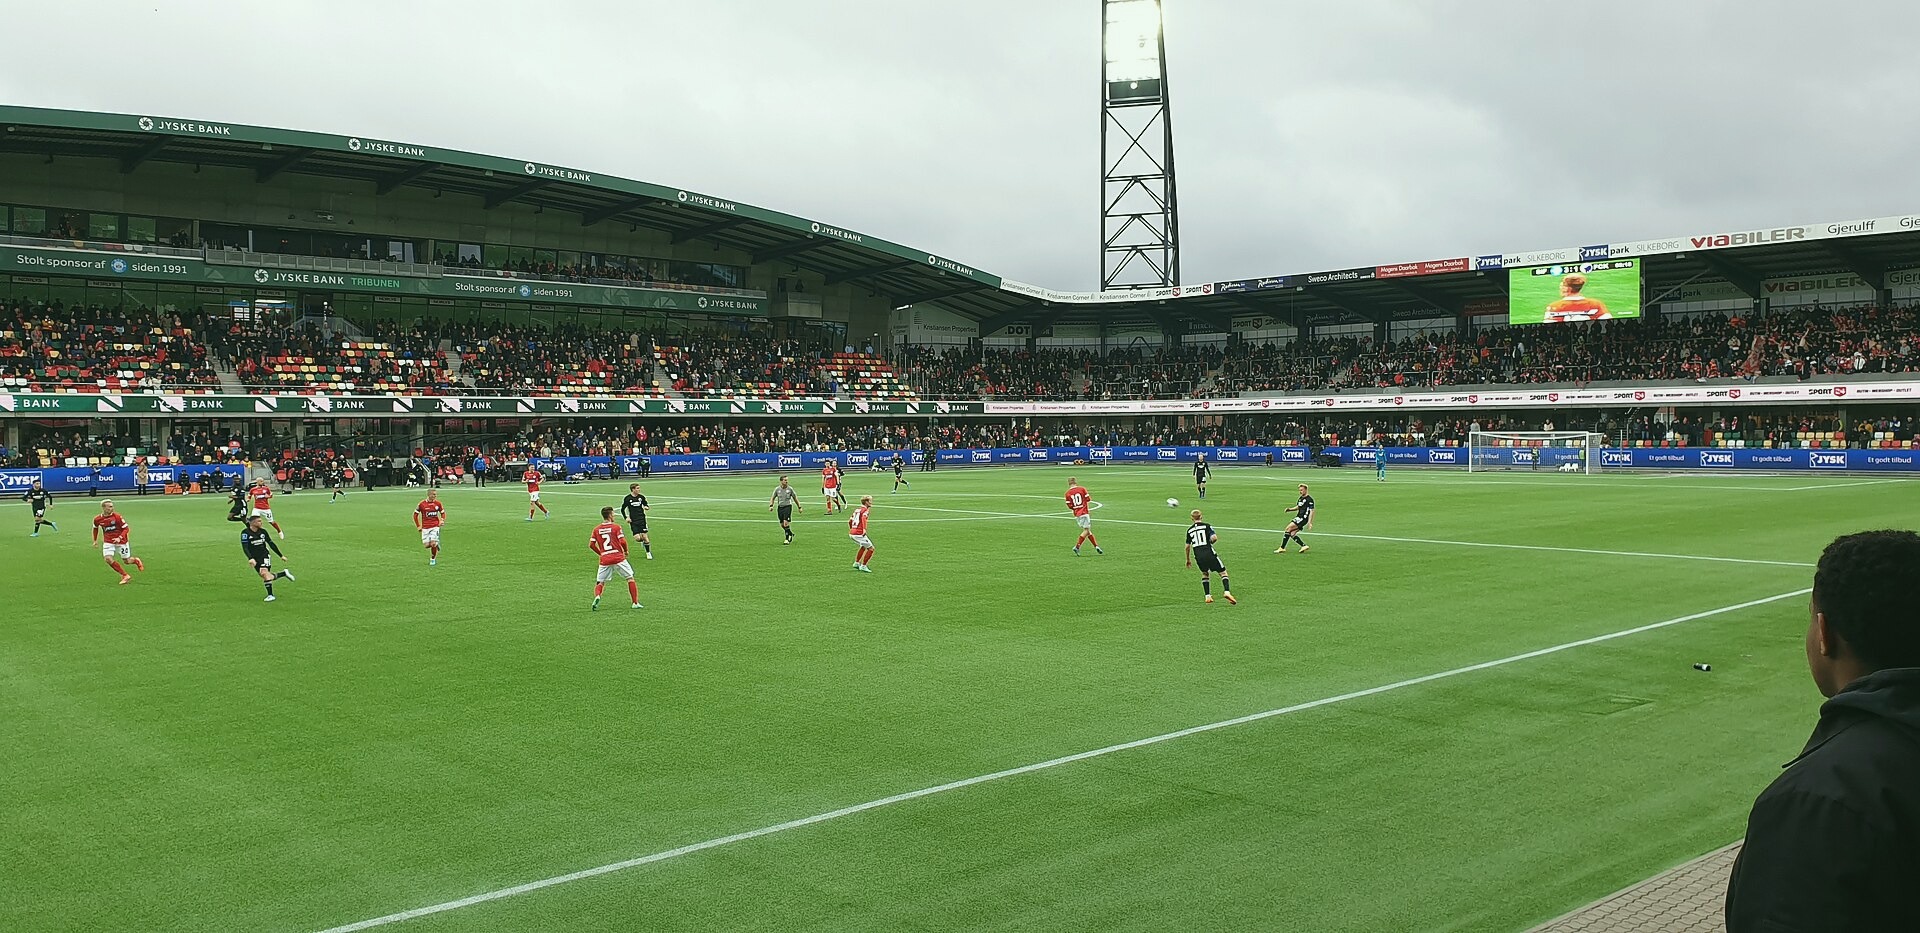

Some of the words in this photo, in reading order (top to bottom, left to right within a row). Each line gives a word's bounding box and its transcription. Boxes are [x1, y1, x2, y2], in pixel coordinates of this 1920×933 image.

[159, 121, 195, 132] JYSKE
[199, 125, 230, 135] BANK
[365, 142, 394, 152] JYSKE
[398, 146, 424, 156] BANK
[539, 167, 564, 178] JYSKE
[568, 172, 591, 182] BANK
[690, 195, 713, 206] JYSKE
[716, 200, 736, 211] BANK
[822, 226, 842, 238] JYSKE
[844, 232, 862, 242] BANK
[1828, 220, 1876, 236] Gjerulff
[1584, 248, 1607, 257] JYSK
[1610, 246, 1630, 256] park
[1636, 241, 1679, 252] SILKEBORG
[17, 254, 44, 266] Stolt
[46, 257, 92, 270] sponsor
[94, 259, 106, 268] af
[1481, 257, 1501, 266] JYSK
[1504, 256, 1521, 266] park
[1528, 253, 1565, 262] SILKEBORG
[132, 263, 160, 272] siden
[163, 264, 188, 274] 1991
[937, 260, 956, 270] JYSKE
[957, 266, 973, 276] BANK
[274, 272, 309, 282] JYSKE
[314, 275, 344, 284] BANK
[352, 278, 400, 288] TRIBUNEN
[1308, 274, 1327, 283] Sweco
[1328, 272, 1358, 280] Architects
[456, 282, 474, 292] Stolt
[476, 284, 508, 295] sponsor
[1682, 290, 1701, 298] park
[710, 300, 734, 308] JYSKE
[736, 301, 757, 310] BANK
[23, 400, 60, 408] BANK
[783, 457, 800, 465] JYSK
[1358, 451, 1376, 459] JYSK
[1434, 452, 1454, 460] JYSK
[1708, 454, 1732, 462] JYSK
[1818, 455, 1845, 464] JYSK
[1071, 493, 1082, 506] 10
[602, 534, 612, 550] 2
[1191, 530, 1207, 548] 30
